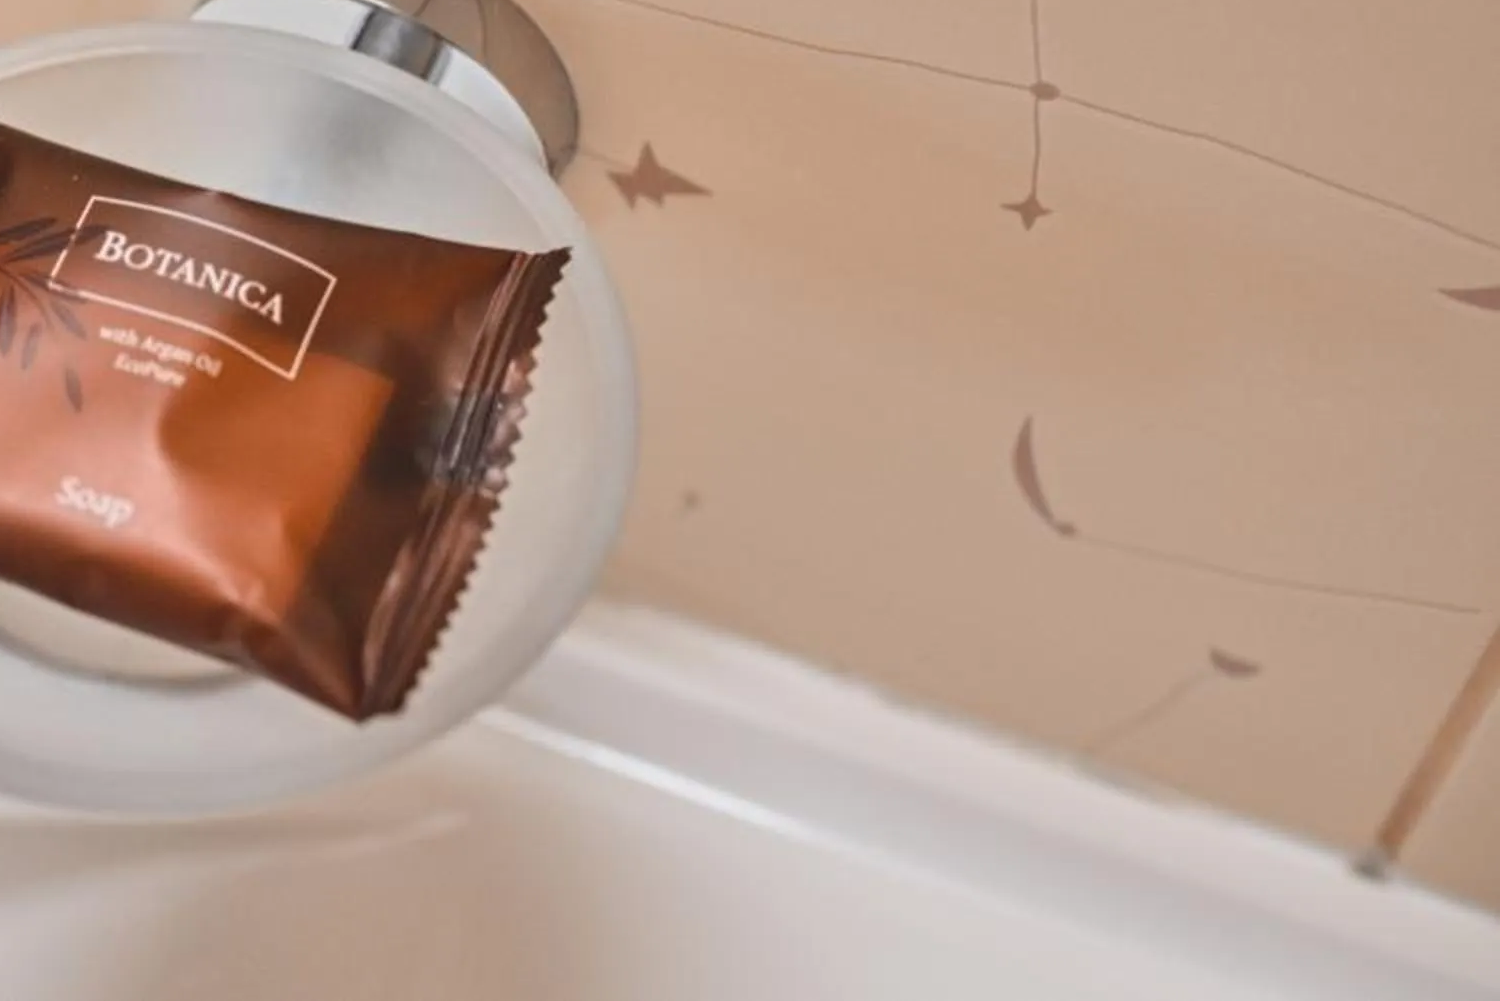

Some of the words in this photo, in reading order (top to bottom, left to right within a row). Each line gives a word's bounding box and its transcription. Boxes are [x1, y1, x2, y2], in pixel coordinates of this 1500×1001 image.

[94, 230, 284, 325] BOTANICA
[99, 325, 139, 347] with
[140, 335, 195, 365] Argan
[195, 352, 223, 378] Oil
[113, 352, 186, 388] EcoPure
[56, 475, 136, 528] Soap
